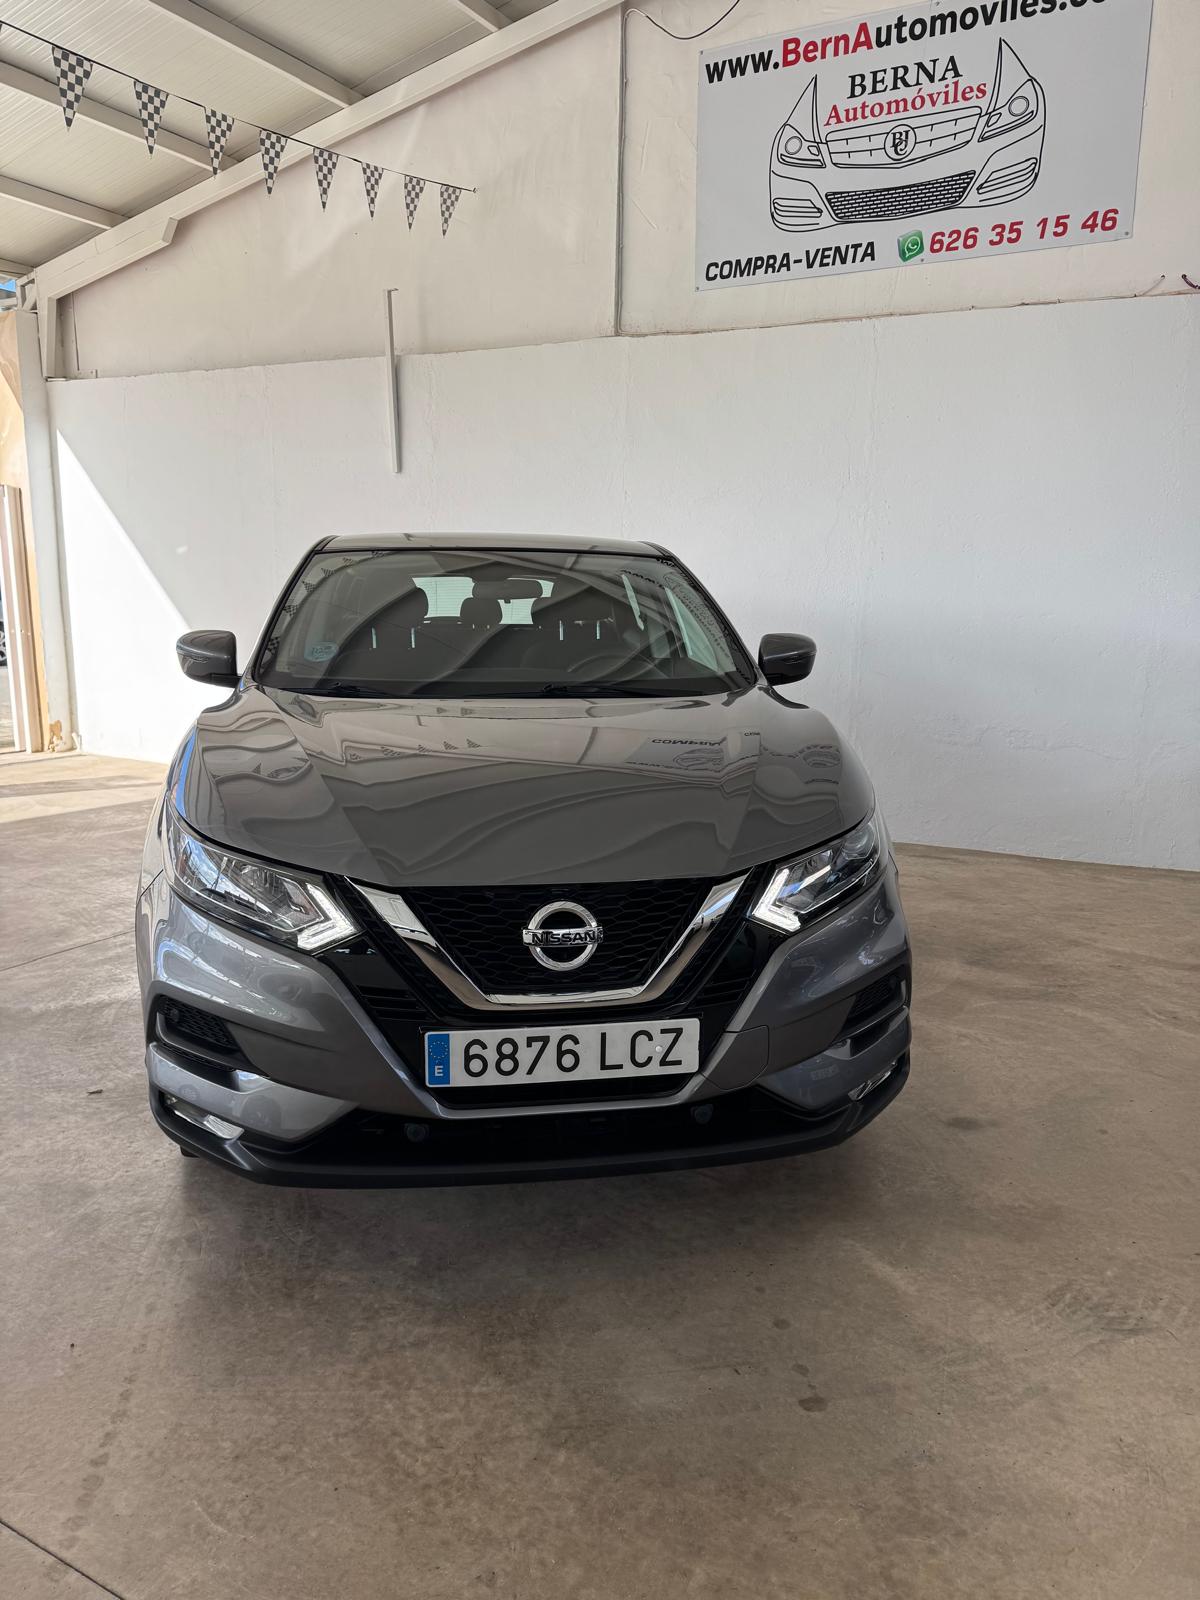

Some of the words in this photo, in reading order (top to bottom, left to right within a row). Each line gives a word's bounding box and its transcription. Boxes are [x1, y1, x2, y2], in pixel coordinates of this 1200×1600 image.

[705, 0, 1105, 84] www.BernAutomoviles.
[847, 55, 963, 99] BERNA
[824, 79, 987, 127] Automóviles
[929, 226, 978, 253] 626
[988, 220, 1023, 246] 35
[1037, 215, 1070, 239] 15
[1081, 208, 1119, 232] 46
[705, 241, 876, 281] COMPRA-VENTA
[531, 930, 596, 944] NISSAN
[434, 1065, 444, 1077] E
[463, 1034, 580, 1078] 6876
[600, 1027, 684, 1071] LCZ
